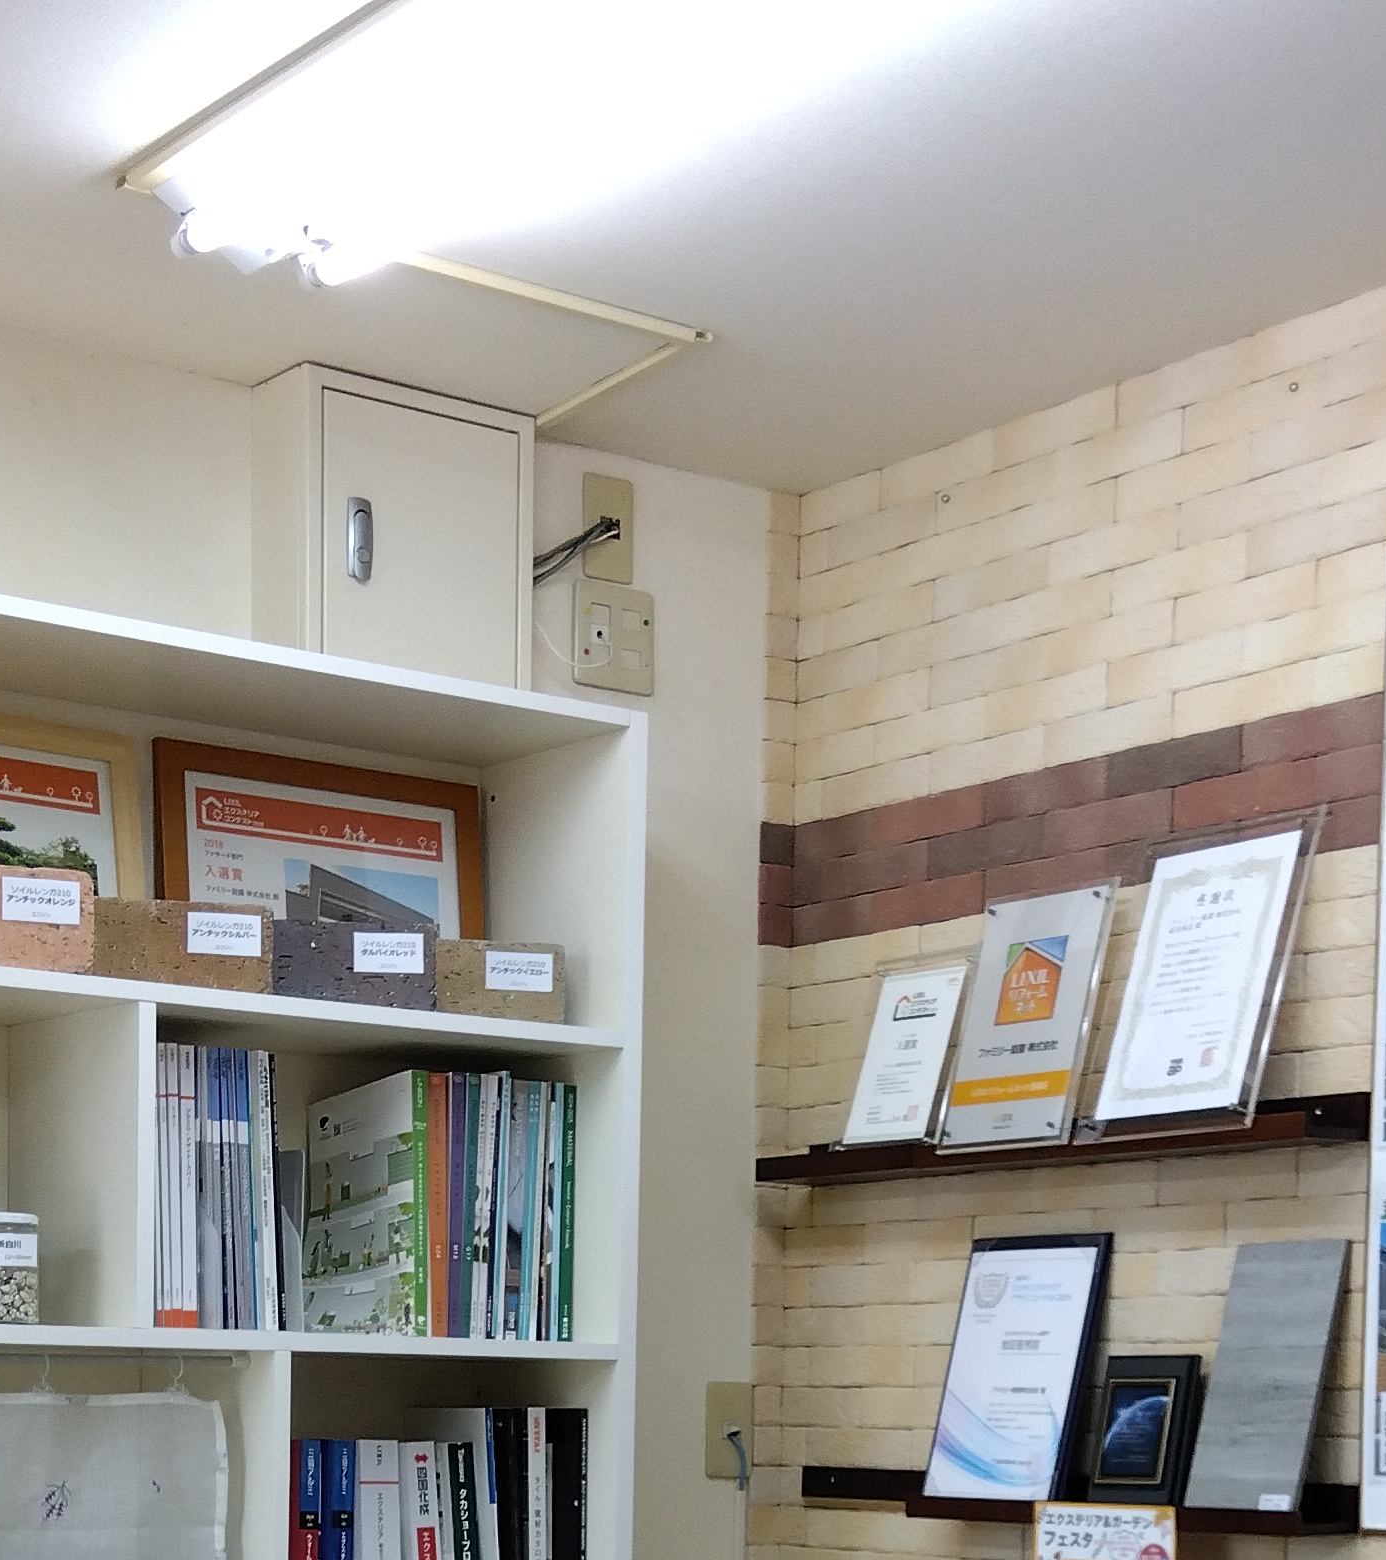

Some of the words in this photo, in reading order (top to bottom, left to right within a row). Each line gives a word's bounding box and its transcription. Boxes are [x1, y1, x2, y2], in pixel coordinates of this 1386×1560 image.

[205, 864, 243, 882] 入選賞
[417, 1467, 430, 1516] 四国化成
[1044, 1530, 1093, 1548] フェスタ
